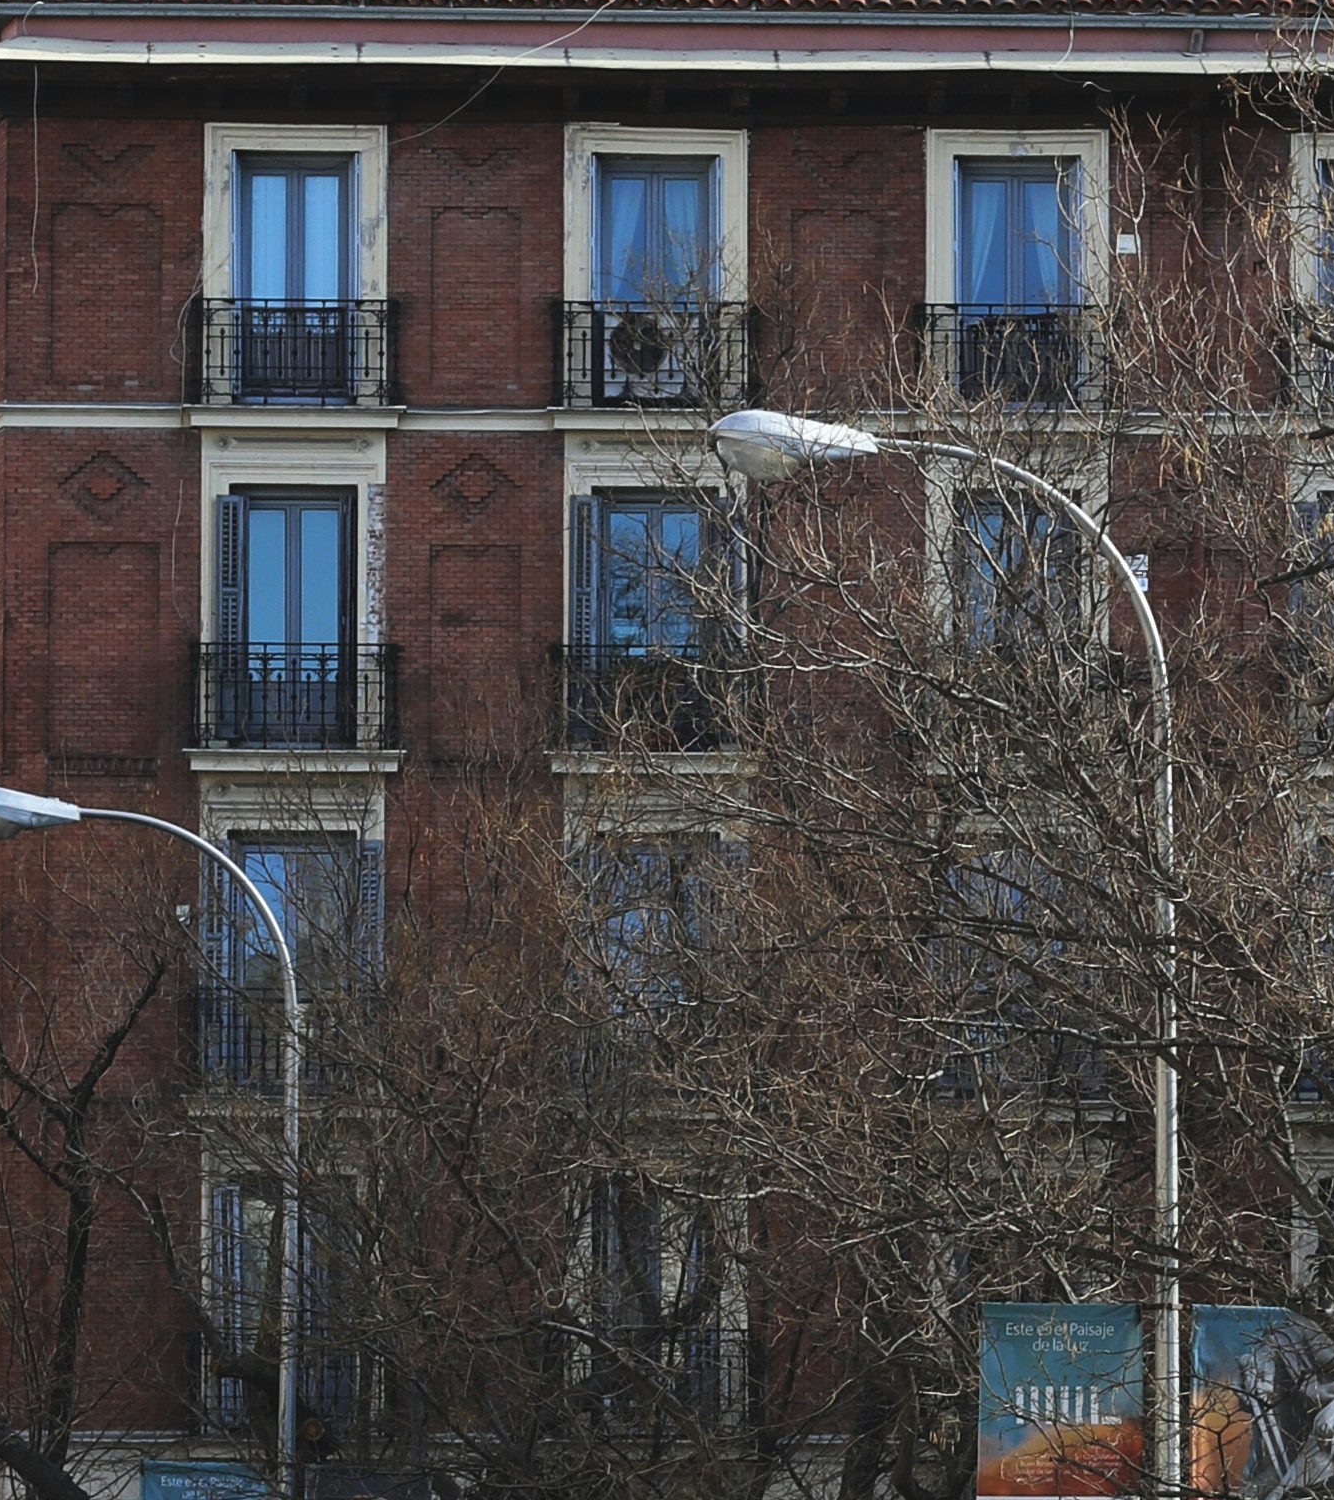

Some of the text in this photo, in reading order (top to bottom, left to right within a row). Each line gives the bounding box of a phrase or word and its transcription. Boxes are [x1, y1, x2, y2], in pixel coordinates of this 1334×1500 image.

[1005, 1322, 1033, 1337] Este
[1069, 1322, 1115, 1339] Paisaje
[1032, 1337, 1050, 1351] de
[1052, 1337, 1064, 1351] la
